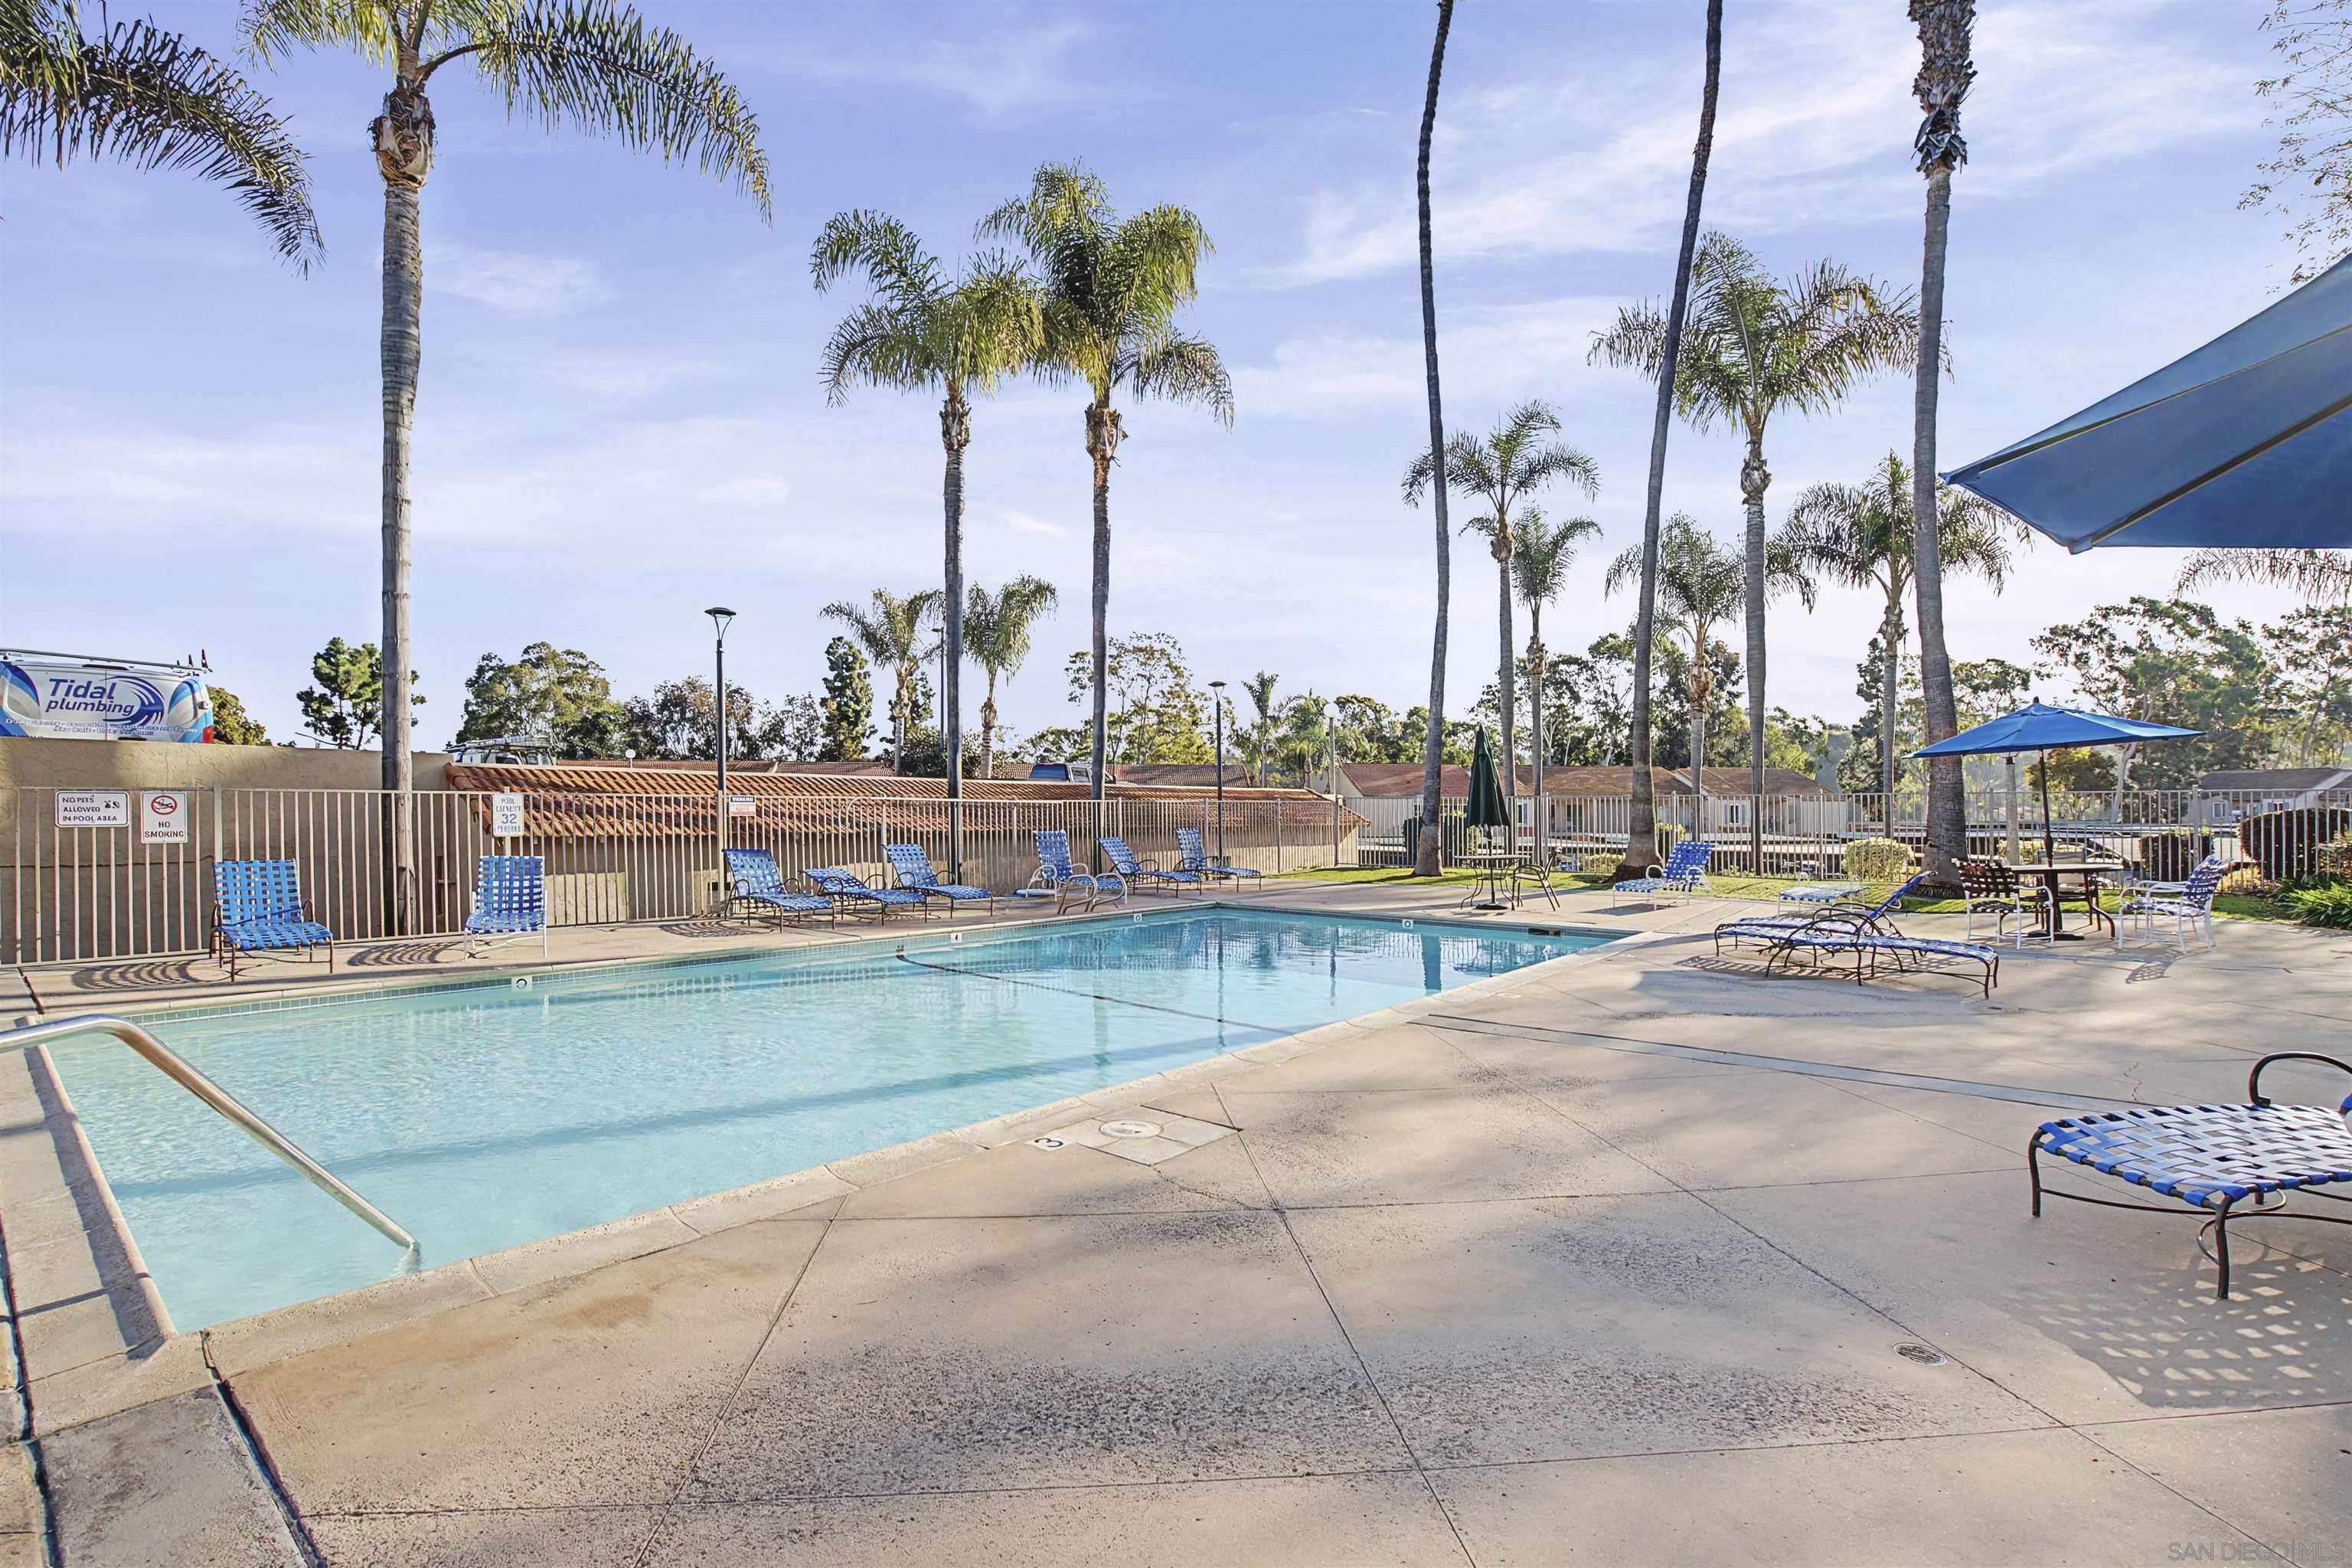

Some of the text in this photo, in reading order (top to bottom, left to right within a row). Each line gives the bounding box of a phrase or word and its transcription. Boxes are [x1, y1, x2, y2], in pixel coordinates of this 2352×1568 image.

[48, 678, 117, 700] Tidal
[45, 697, 135, 716] plumbing
[501, 813, 517, 824] 32
[1034, 1138, 1063, 1148] 3
